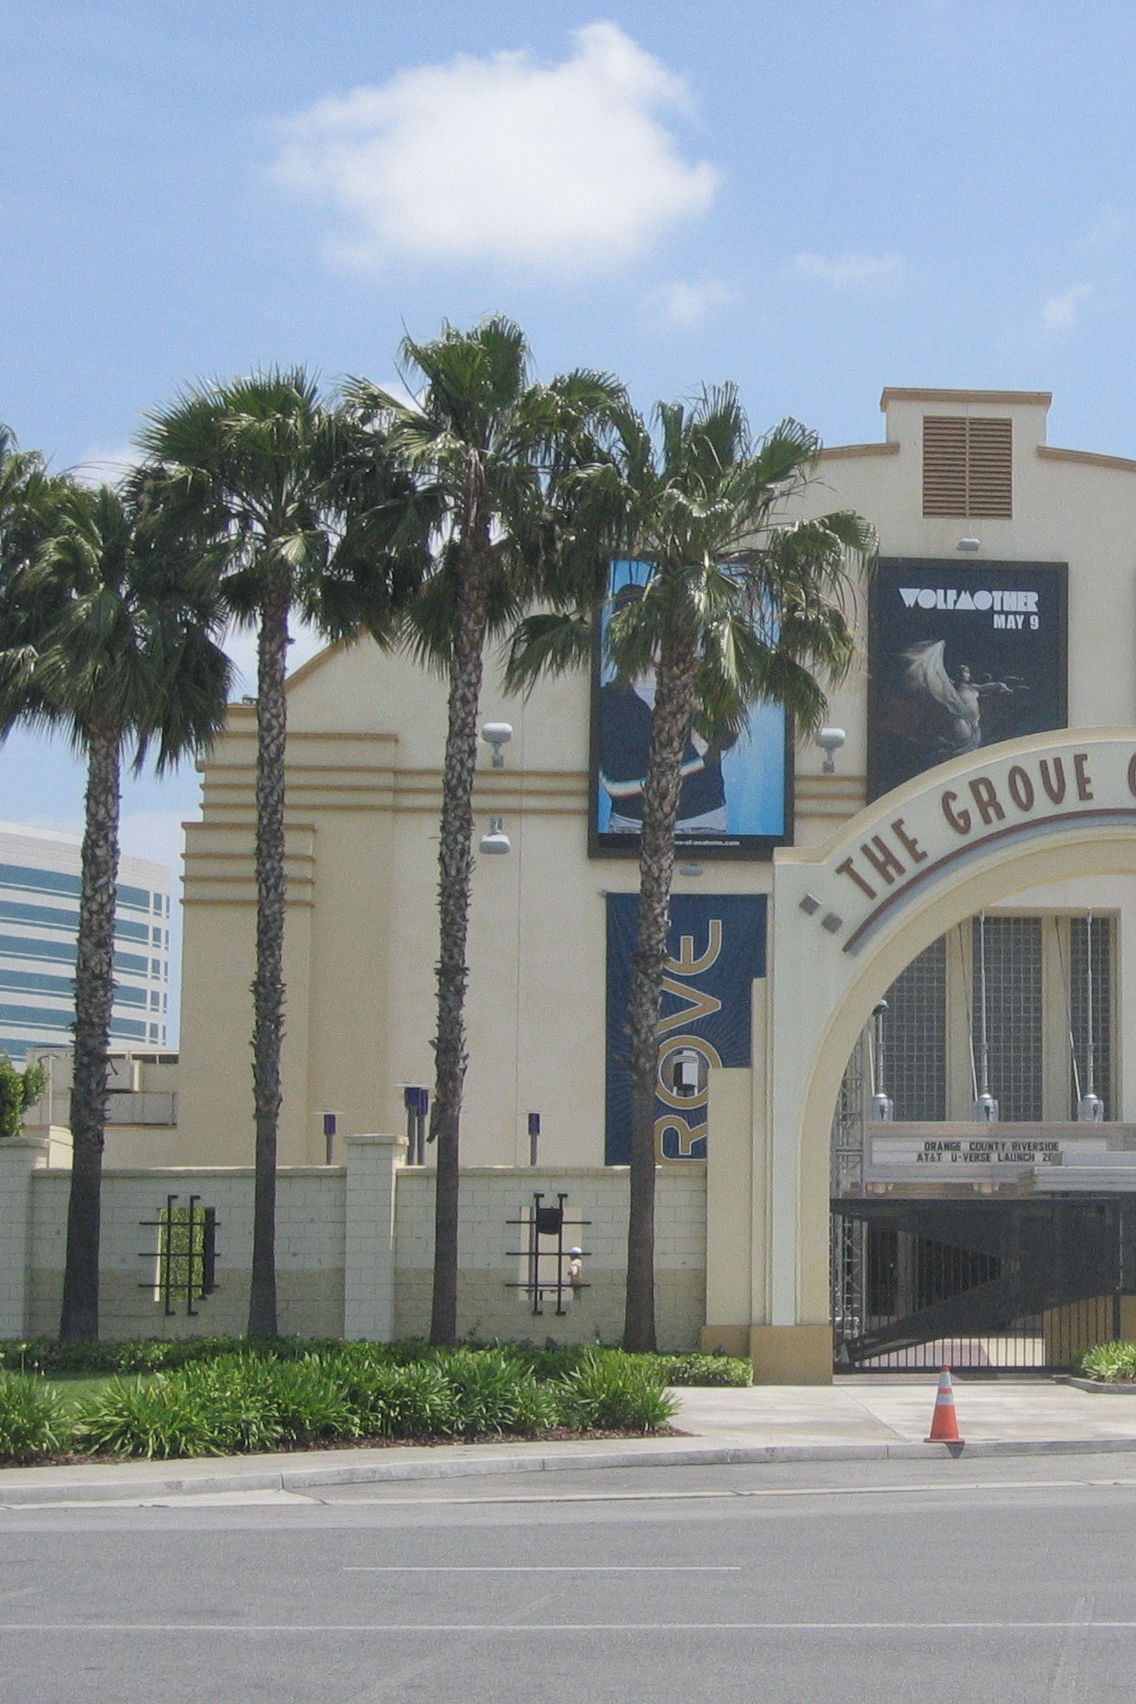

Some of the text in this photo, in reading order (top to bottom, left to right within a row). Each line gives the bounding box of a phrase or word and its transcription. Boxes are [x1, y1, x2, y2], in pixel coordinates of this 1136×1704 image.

[899, 588, 1039, 611] WOLFMOTHER
[993, 614, 1039, 630] MAY 9
[835, 818, 928, 900] THE
[942, 753, 1093, 835] GROVE
[655, 919, 723, 1166] ROVE
[924, 1141, 1059, 1151] ORANGE COUNTY RIVERSIDE
[917, 1152, 941, 1162] AT&T
[951, 1152, 992, 1162] U-VERSE
[997, 1152, 1035, 1162] LAUNCH
